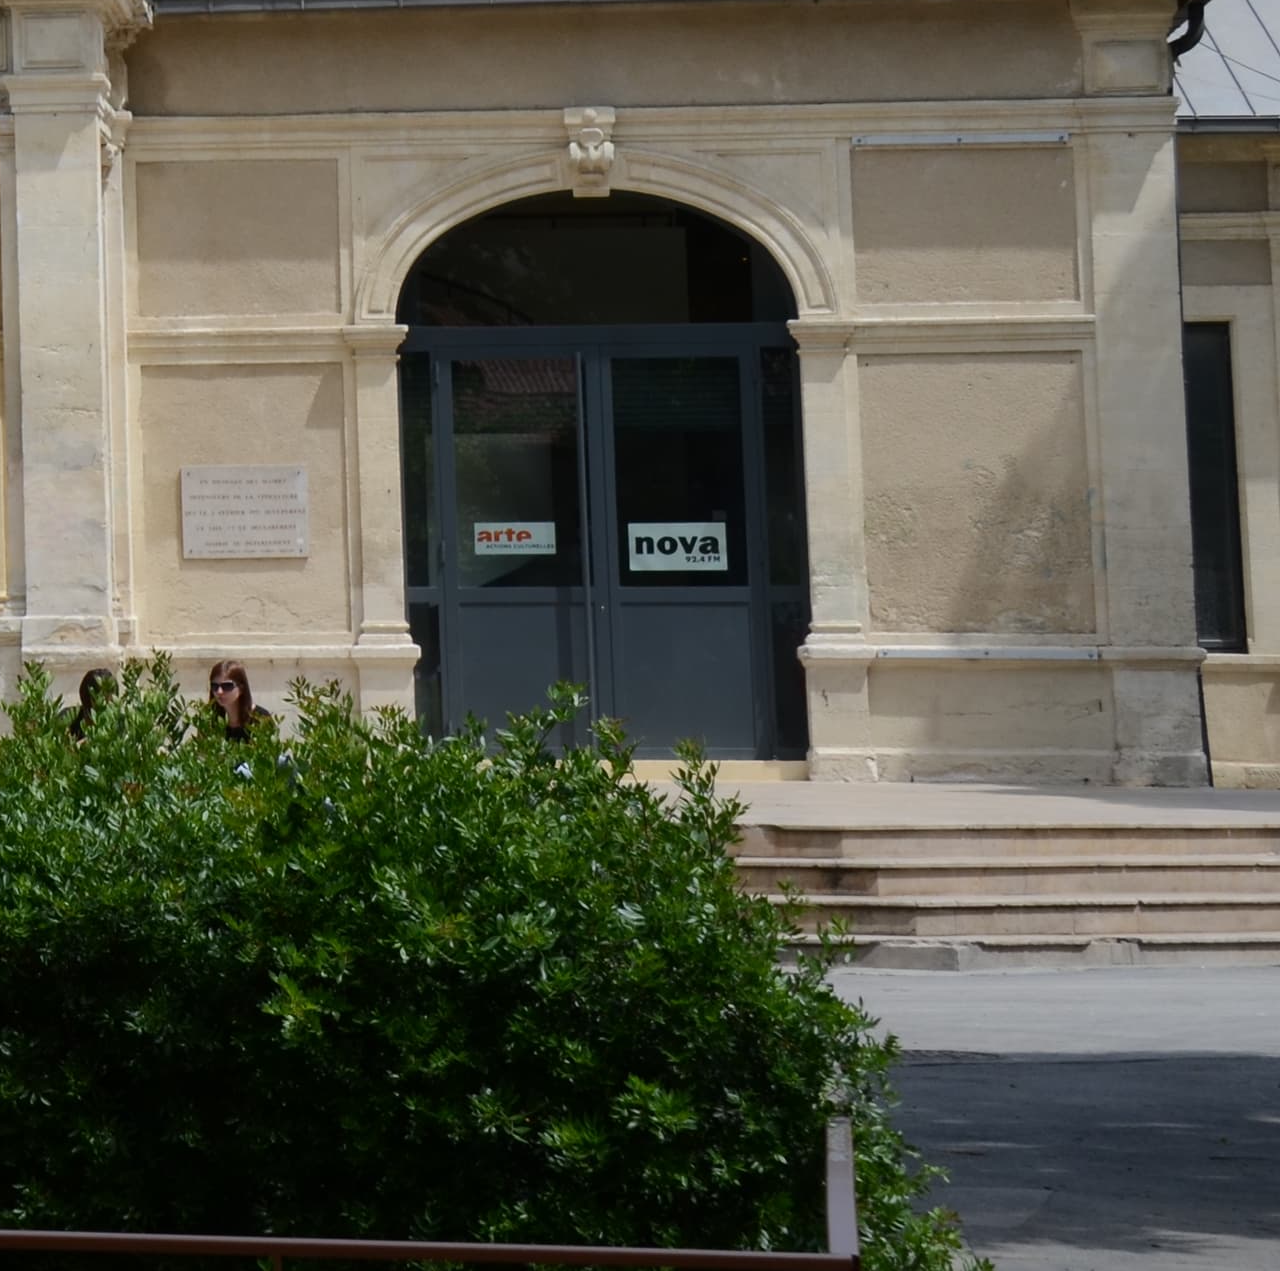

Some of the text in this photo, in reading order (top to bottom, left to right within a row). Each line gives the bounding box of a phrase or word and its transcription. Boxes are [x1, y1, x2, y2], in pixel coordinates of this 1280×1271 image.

[476, 528, 532, 543] arte
[635, 536, 720, 555] nova
[707, 555, 721, 563] FM
